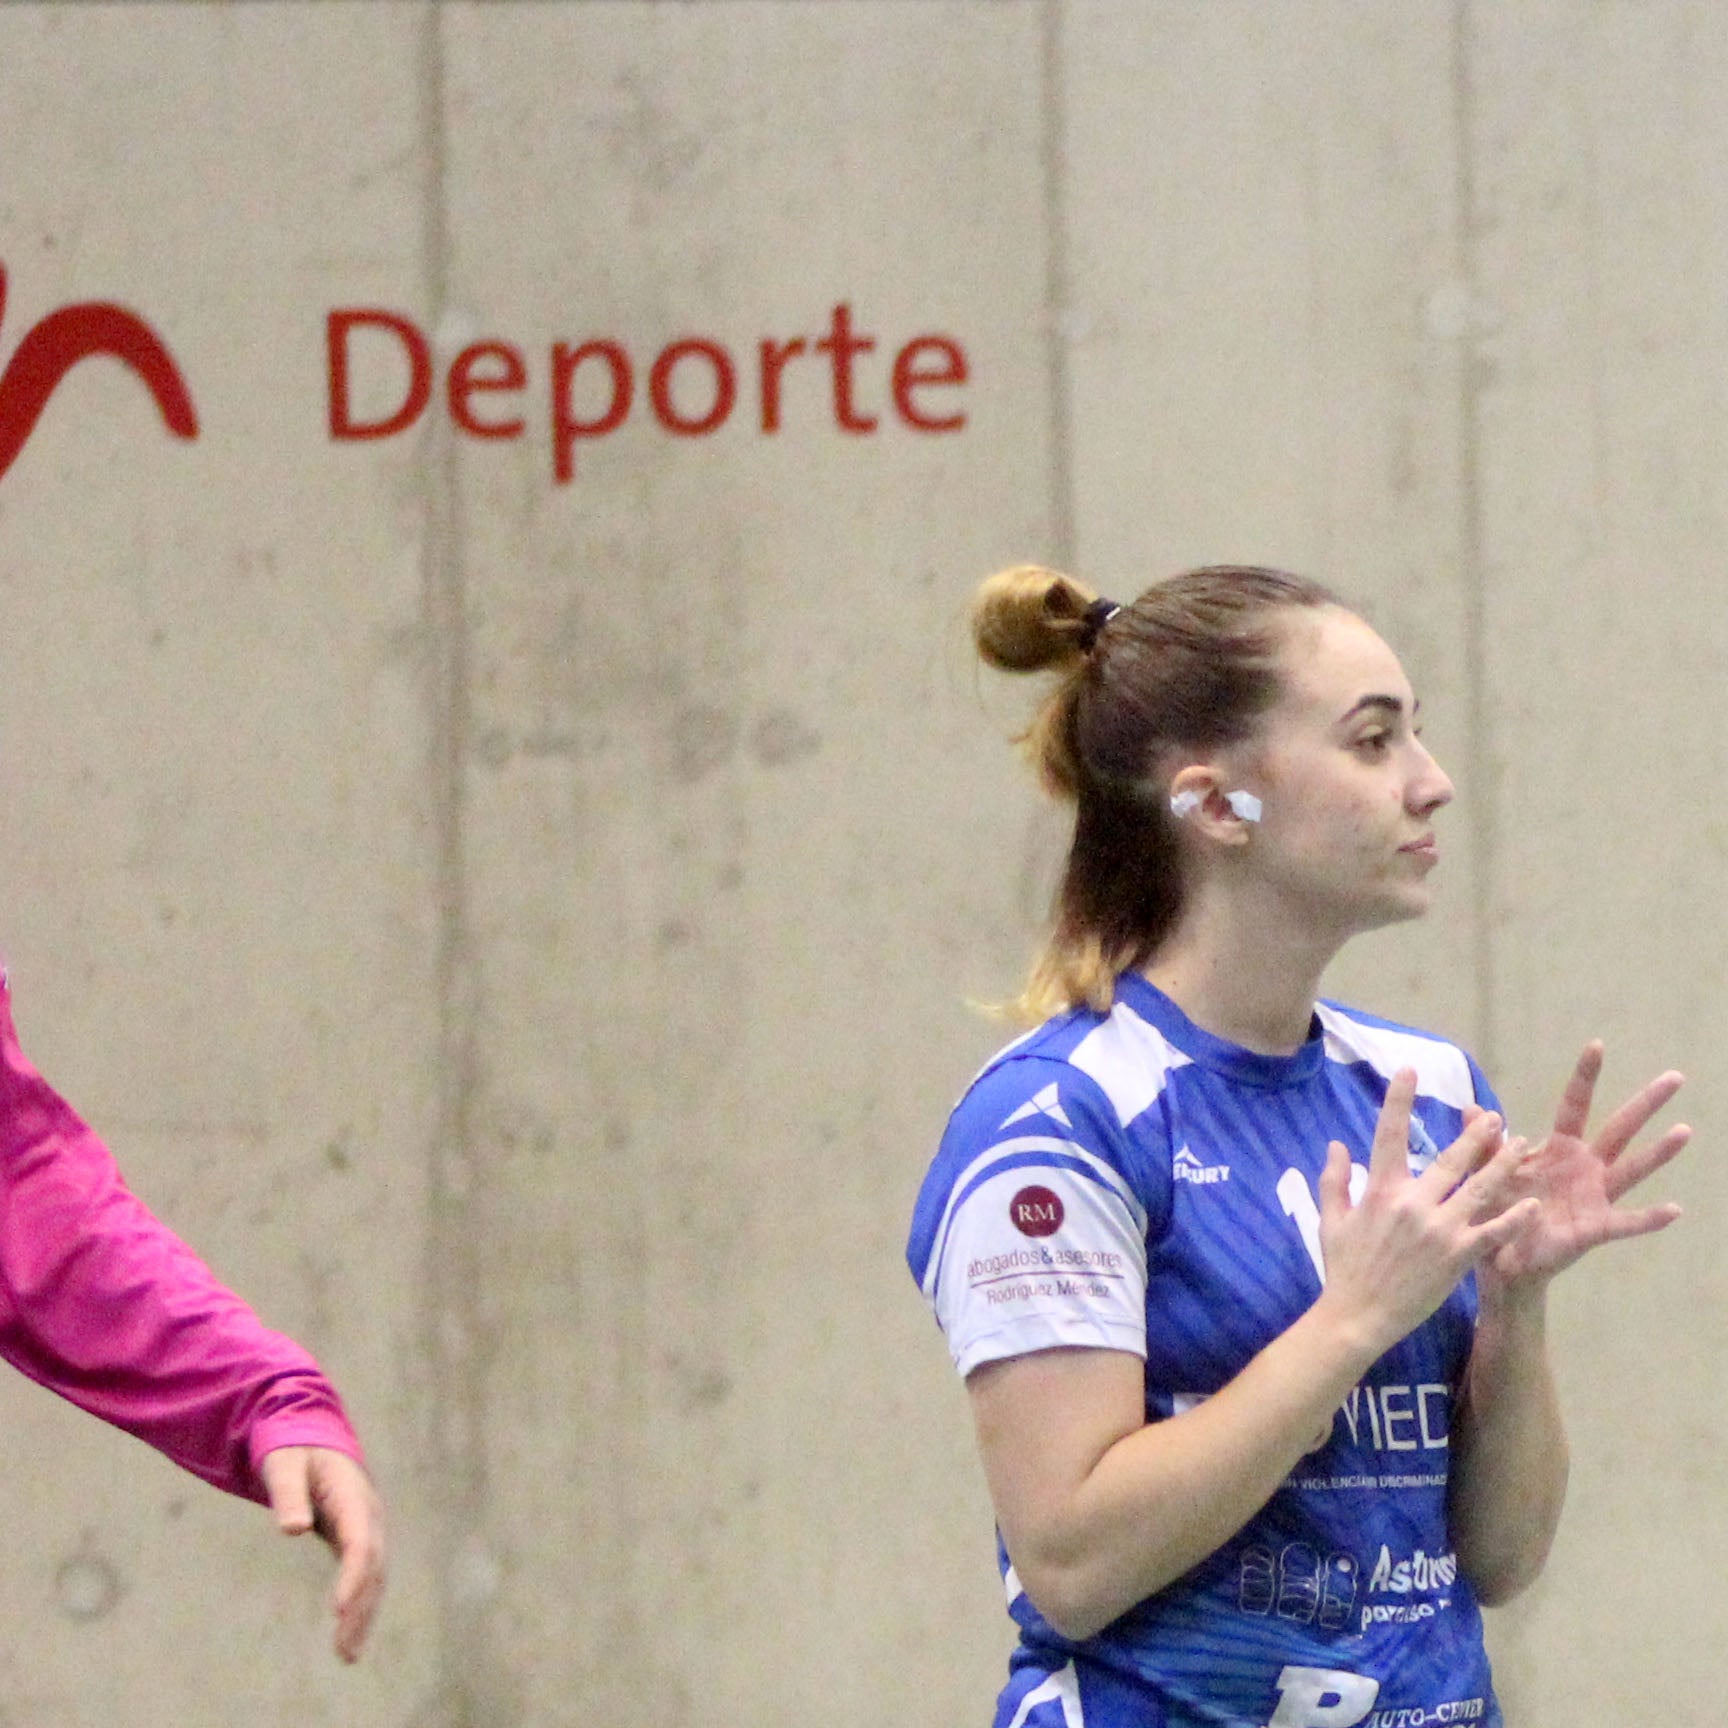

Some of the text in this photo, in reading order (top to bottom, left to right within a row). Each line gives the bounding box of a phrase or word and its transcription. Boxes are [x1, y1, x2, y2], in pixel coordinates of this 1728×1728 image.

[326, 301, 969, 484] Deporte
[1017, 1203, 1056, 1223] RM
[1342, 1384, 1449, 1450] VIED
